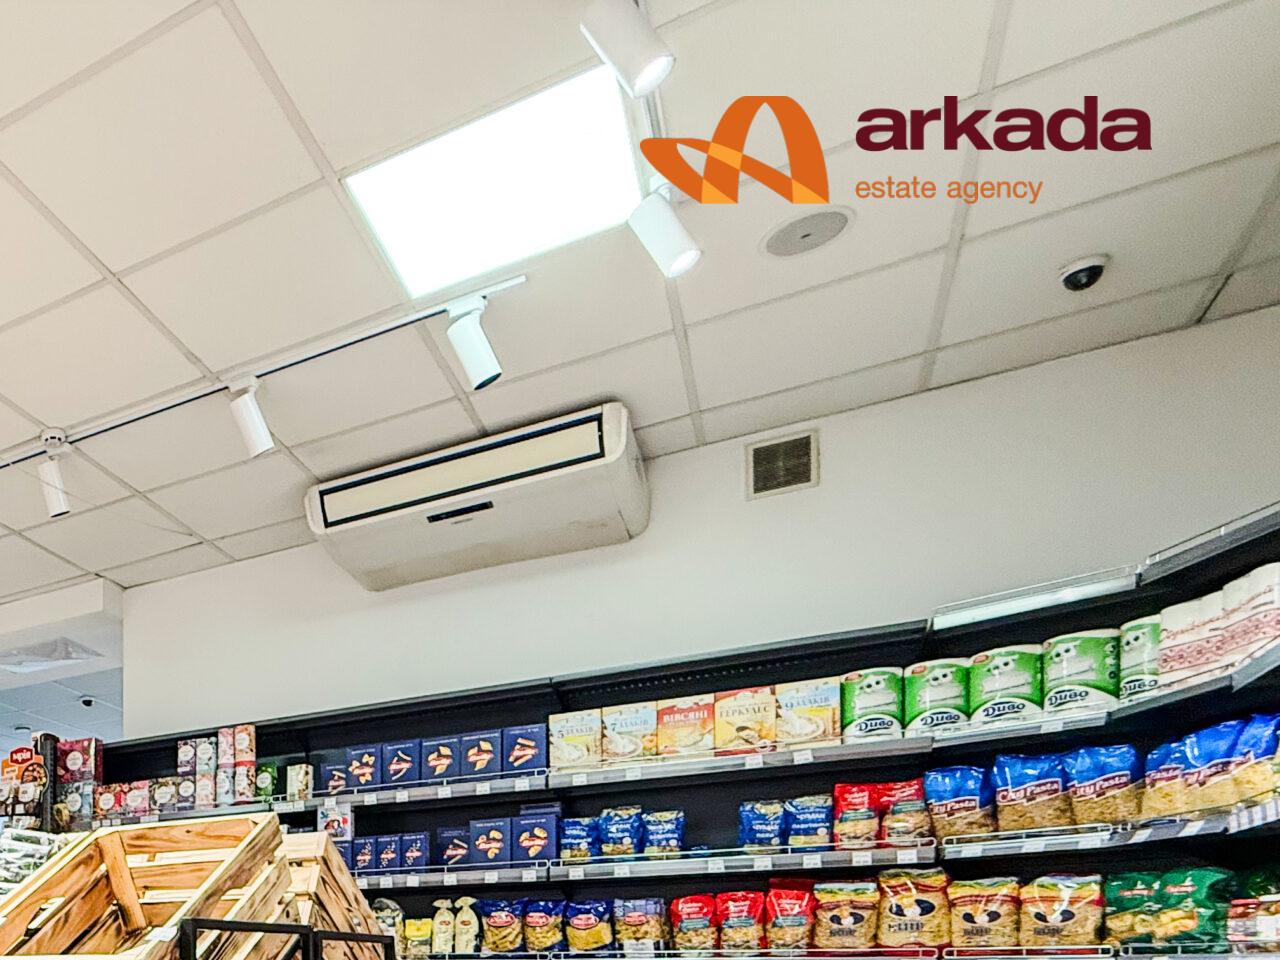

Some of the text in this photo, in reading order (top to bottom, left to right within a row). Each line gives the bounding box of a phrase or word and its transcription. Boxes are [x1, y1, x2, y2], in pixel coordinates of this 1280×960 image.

[1047, 690, 1090, 706] Диво
[982, 703, 1026, 718] Диво
[856, 719, 894, 732] Диво
[920, 714, 961, 727] Диво
[1026, 782, 1059, 797] Pasta
[1095, 774, 1129, 790] Pasta
[947, 800, 977, 813] Pasta
